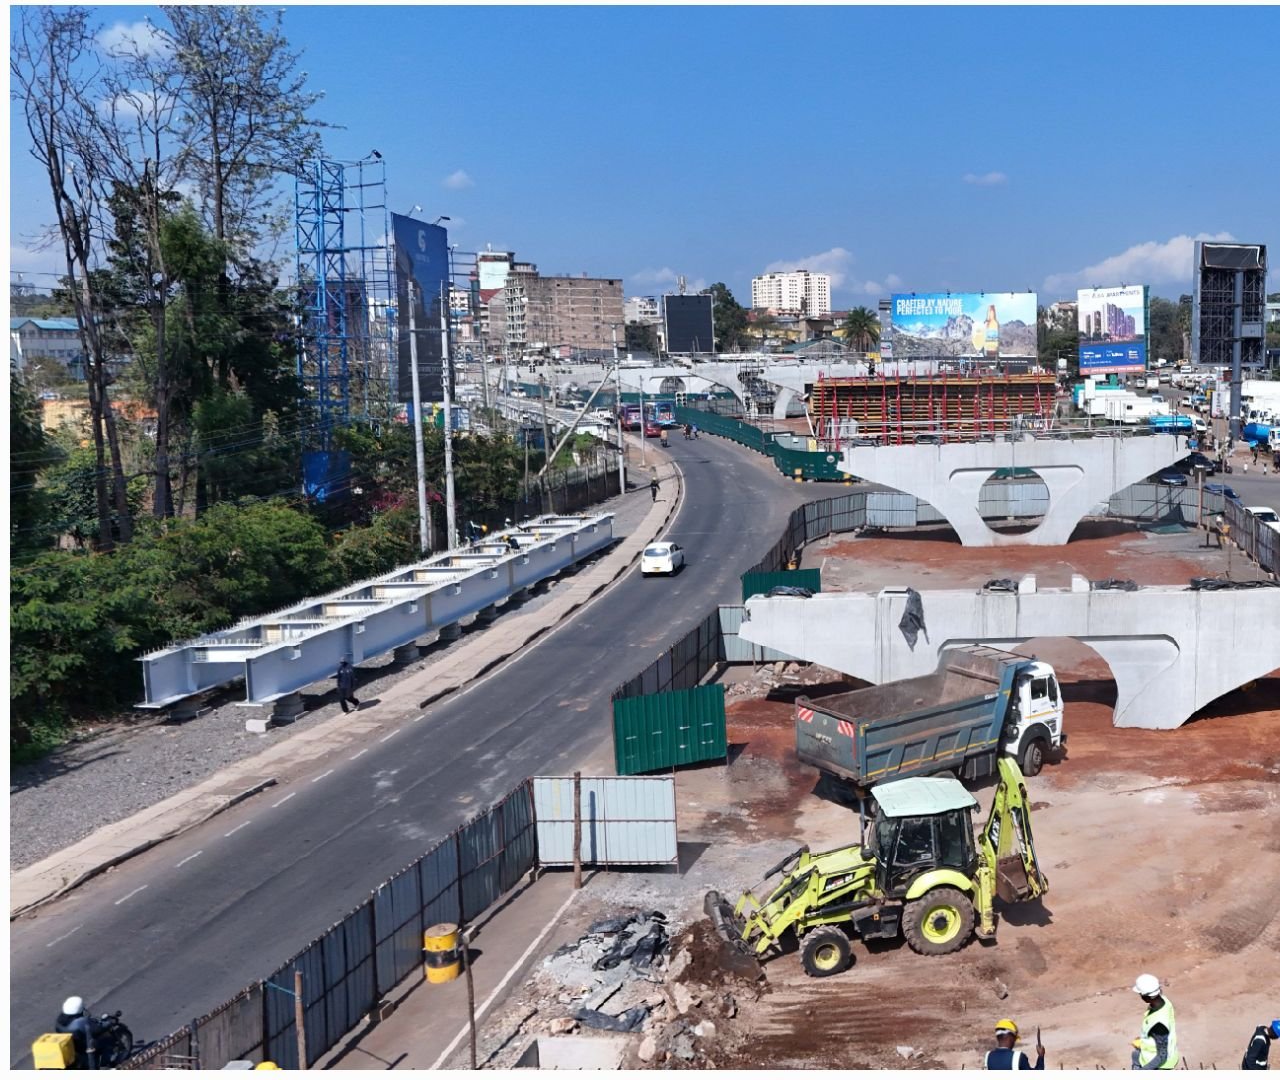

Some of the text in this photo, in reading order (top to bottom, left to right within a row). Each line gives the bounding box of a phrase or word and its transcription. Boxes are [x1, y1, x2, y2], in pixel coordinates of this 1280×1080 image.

[896, 299, 926, 307] CRAFTED
[927, 299, 936, 307] BY
[896, 307, 932, 315] PERFECTED
[934, 307, 944, 315] TO
